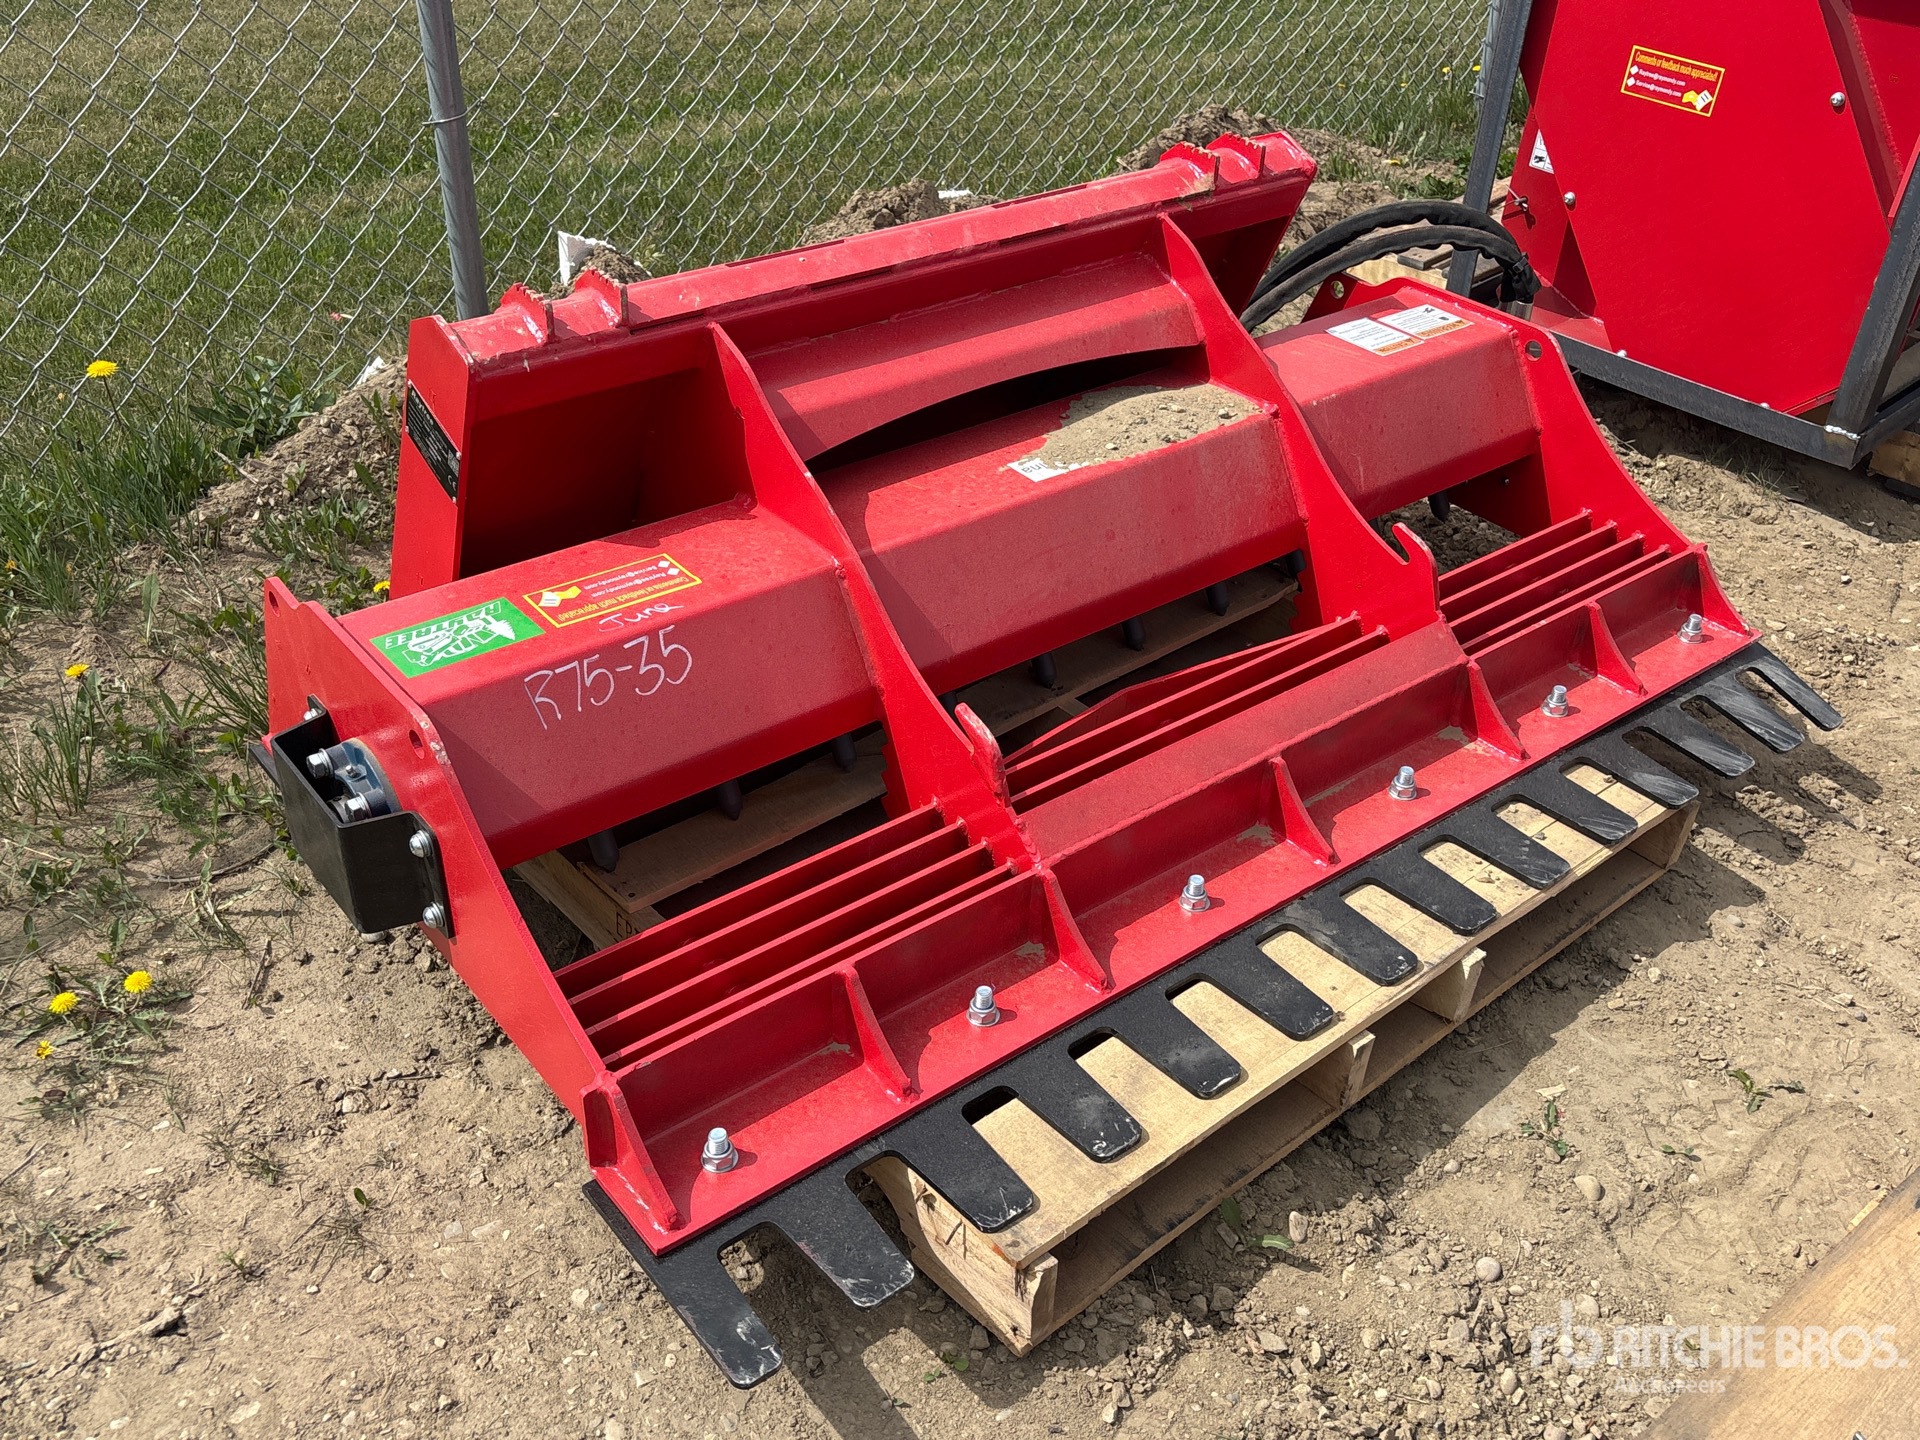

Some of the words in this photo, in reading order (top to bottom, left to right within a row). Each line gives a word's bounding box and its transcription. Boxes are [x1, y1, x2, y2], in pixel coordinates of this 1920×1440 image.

[1635, 52, 1656, 66] Comments
[1679, 64, 1692, 74] much
[651, 575, 689, 590] Comments
[596, 597, 619, 608] much
[614, 588, 648, 602] feedback
[554, 602, 600, 621] appreciated!
[385, 601, 501, 649] RAYTREE
[523, 624, 693, 730] R75-35
